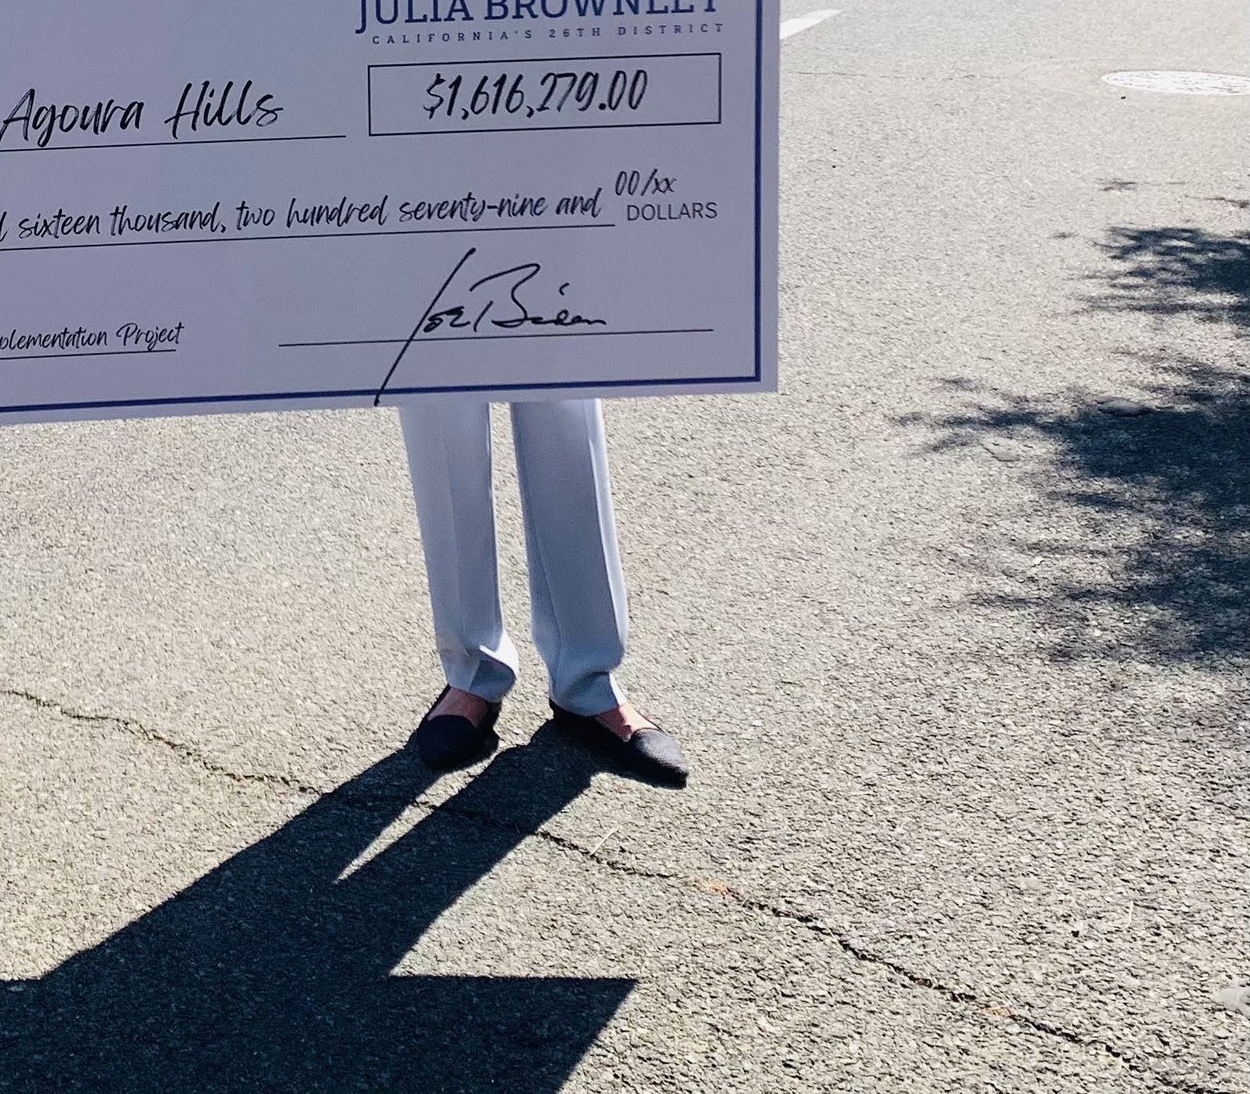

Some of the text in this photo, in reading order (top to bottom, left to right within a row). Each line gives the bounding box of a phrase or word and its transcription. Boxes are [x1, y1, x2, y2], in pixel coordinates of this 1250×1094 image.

[372, 22, 724, 45] CALIFORNIA'S 26TH DISTRICT
[163, 79, 285, 140] Hills
[422, 69, 649, 121] $1,616,279.00
[18, 208, 101, 240] sixteen
[109, 201, 227, 237] thousand,
[235, 200, 276, 232] two
[285, 194, 389, 229] hundred
[398, 191, 549, 223] seventy-nine
[554, 186, 603, 219] and
[626, 201, 718, 222] DOLLARS
[115, 320, 186, 354] Project
